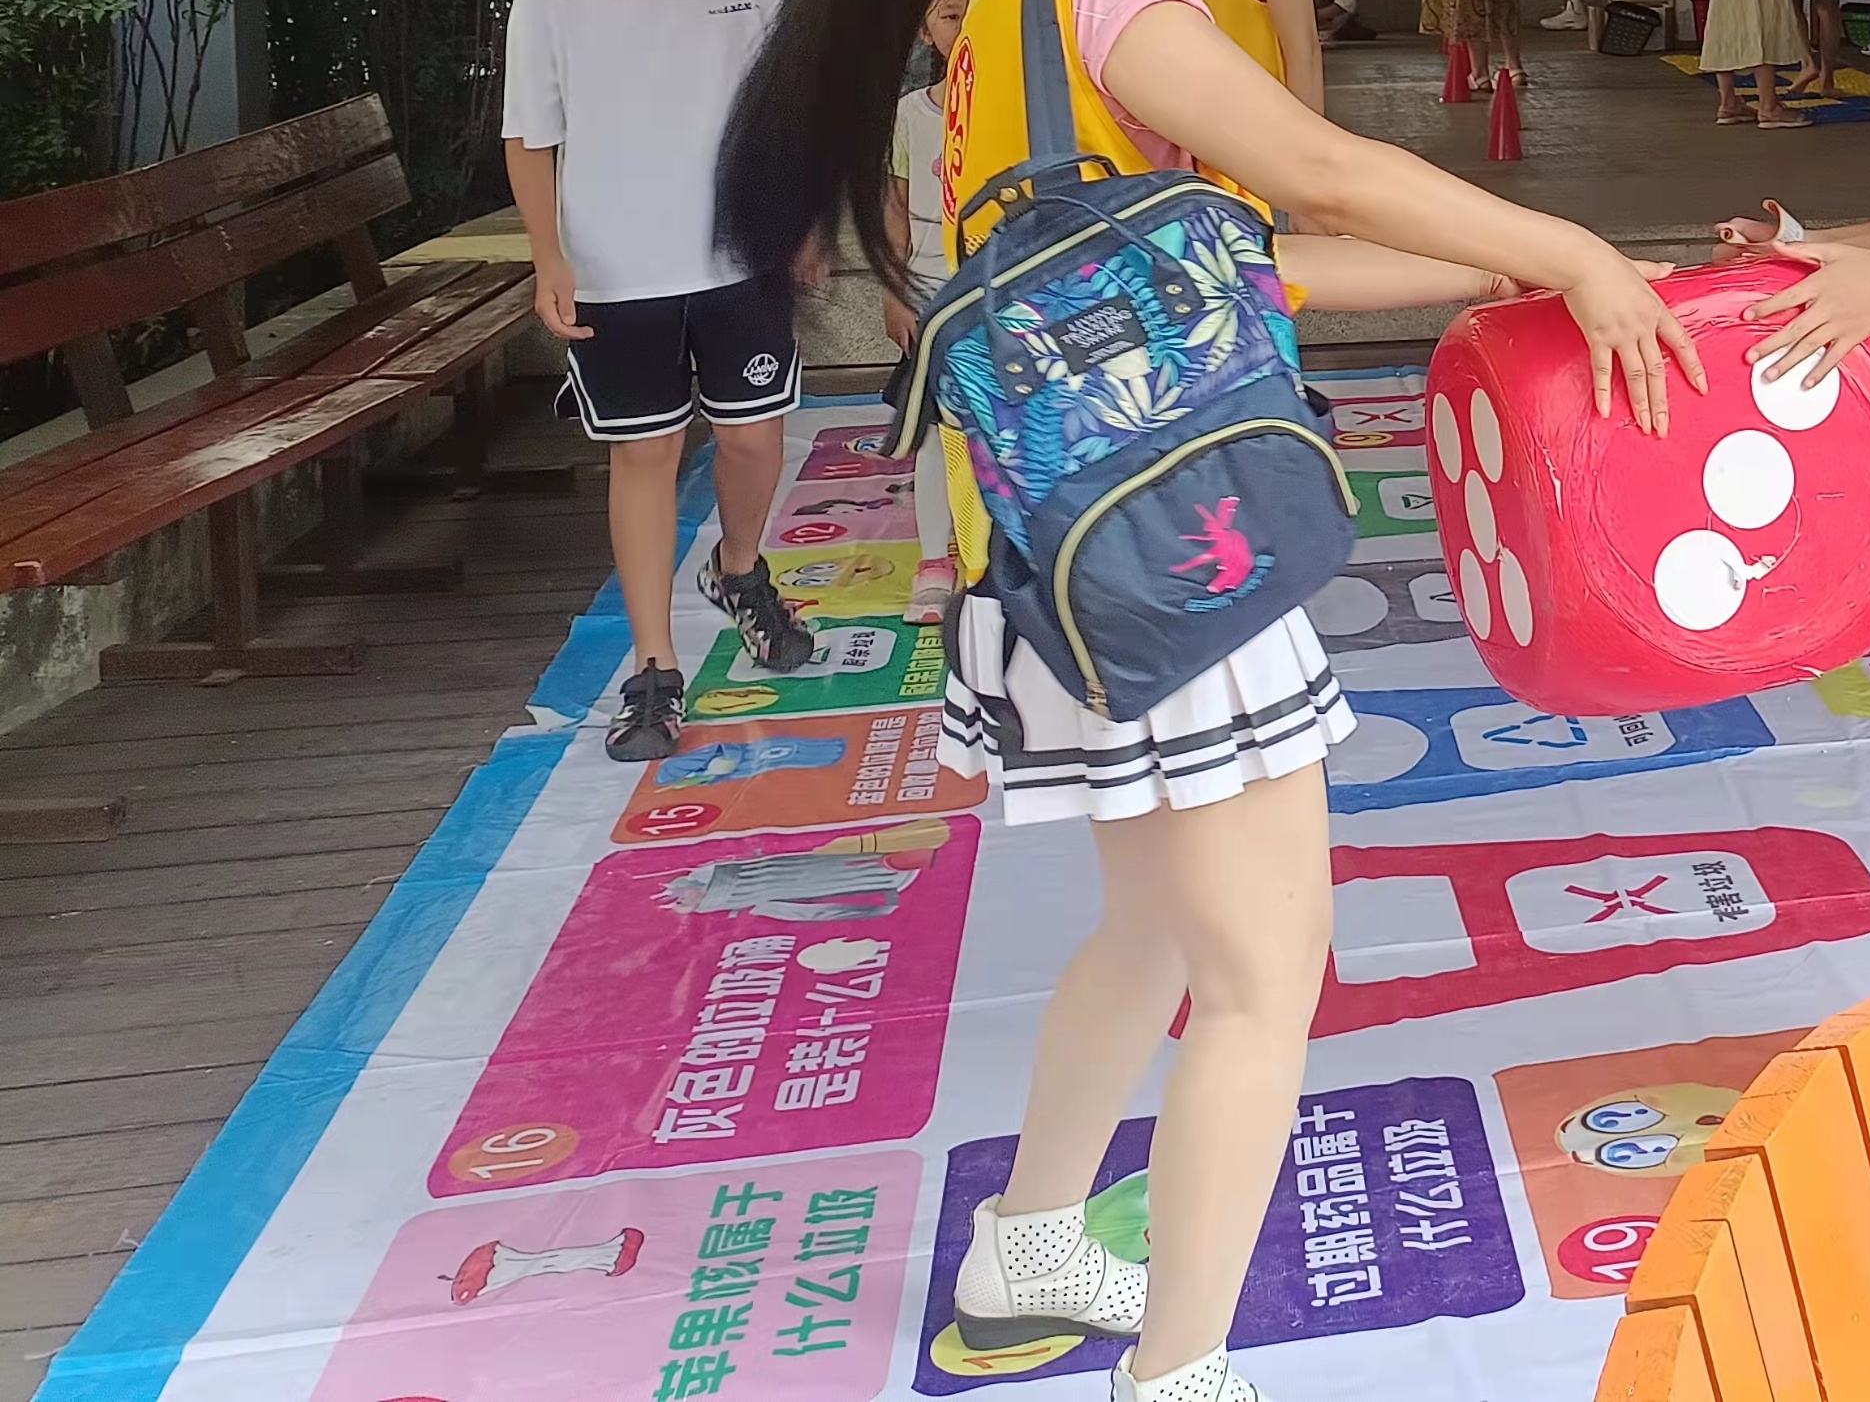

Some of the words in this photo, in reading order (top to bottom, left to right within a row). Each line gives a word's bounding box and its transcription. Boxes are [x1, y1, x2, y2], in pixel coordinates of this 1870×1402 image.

[790, 524, 837, 544] 12
[641, 804, 703, 837] 15
[1691, 860, 1751, 923] 有害垃圾
[649, 932, 801, 1146] 灰色的垃圾桶
[468, 1125, 562, 1183] 16
[1294, 1104, 1382, 1309] 过期药品属于
[1382, 1116, 1473, 1256] 什么垃圾
[653, 1180, 786, 1402] 苹果核属于
[771, 1183, 882, 1360] 什么垃圾
